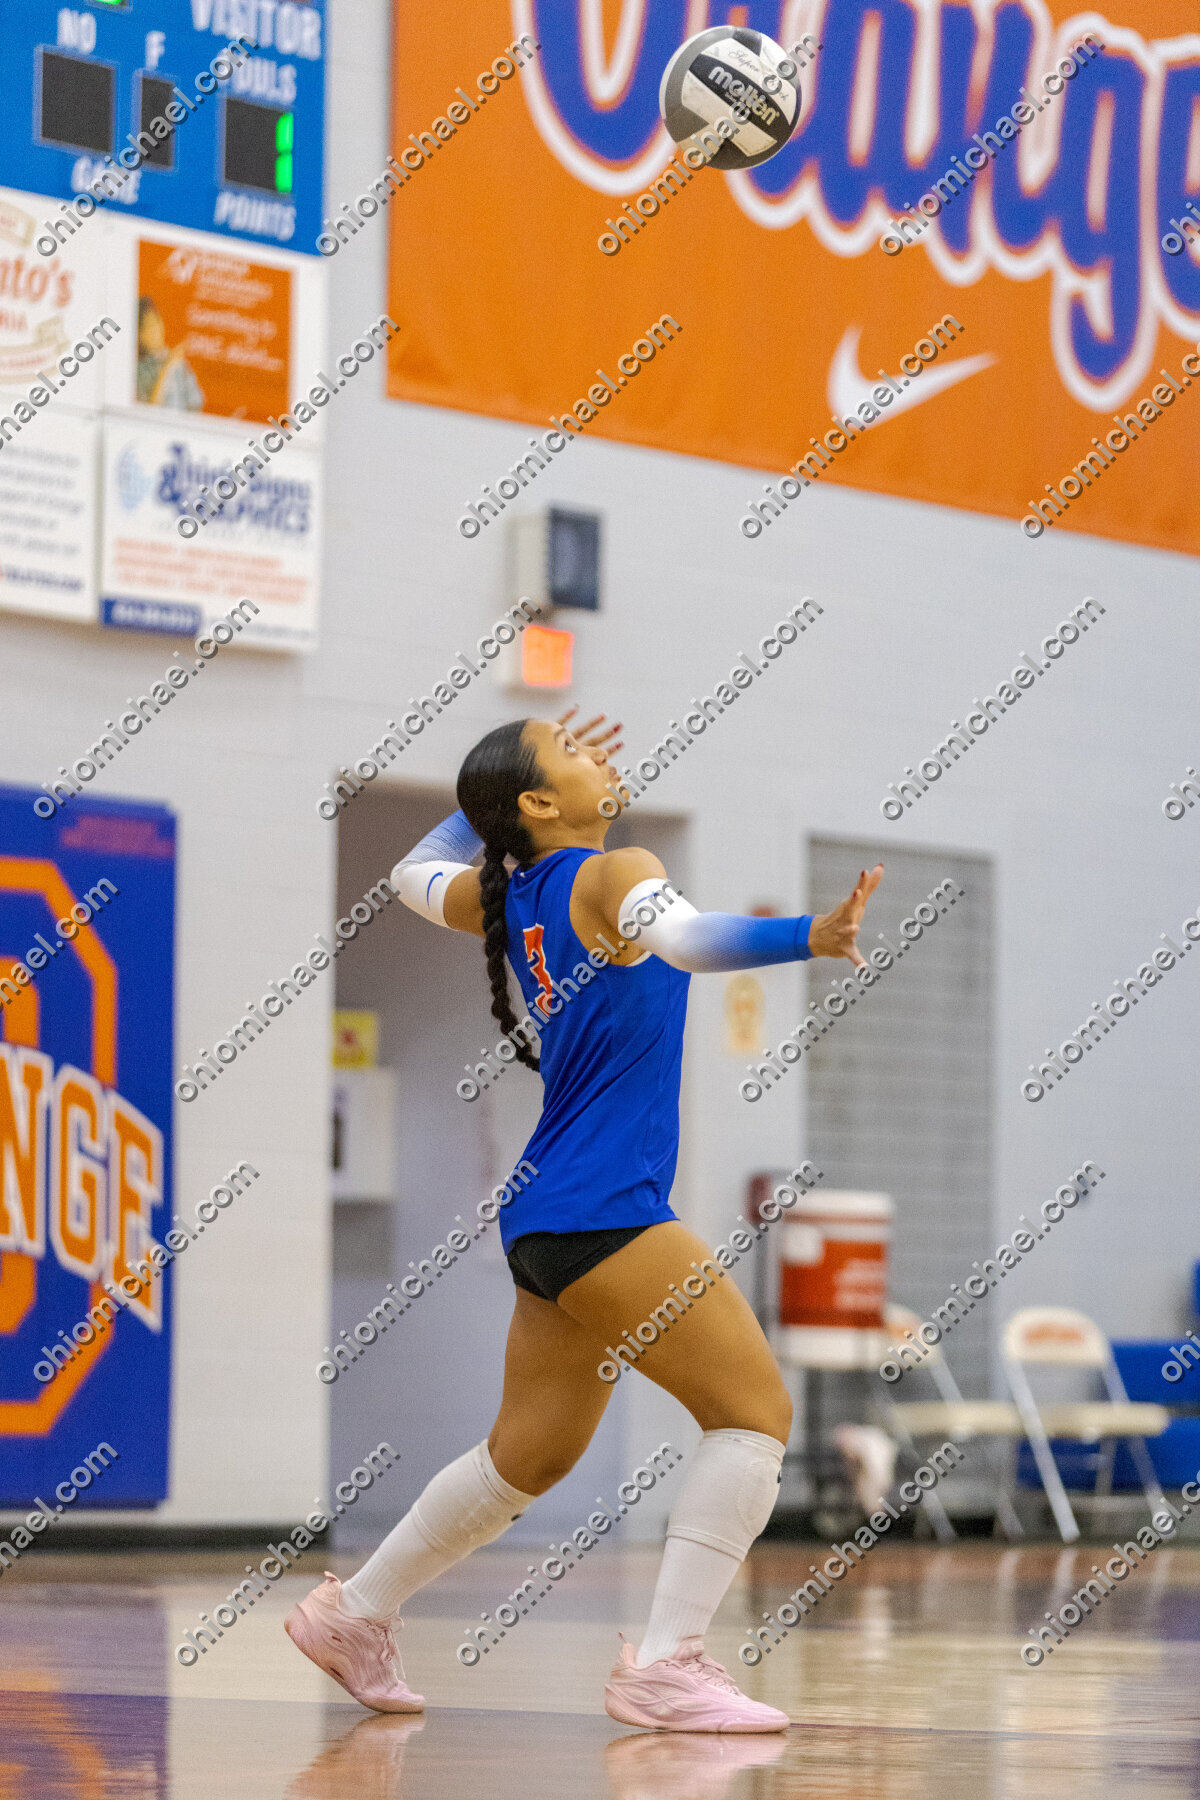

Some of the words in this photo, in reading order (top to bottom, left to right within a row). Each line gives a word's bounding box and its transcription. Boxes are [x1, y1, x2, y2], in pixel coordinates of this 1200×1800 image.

[57, 8, 97, 54] NO
[145, 31, 166, 70] F
[0, 255, 76, 309] to's
[523, 922, 553, 1017] 3
